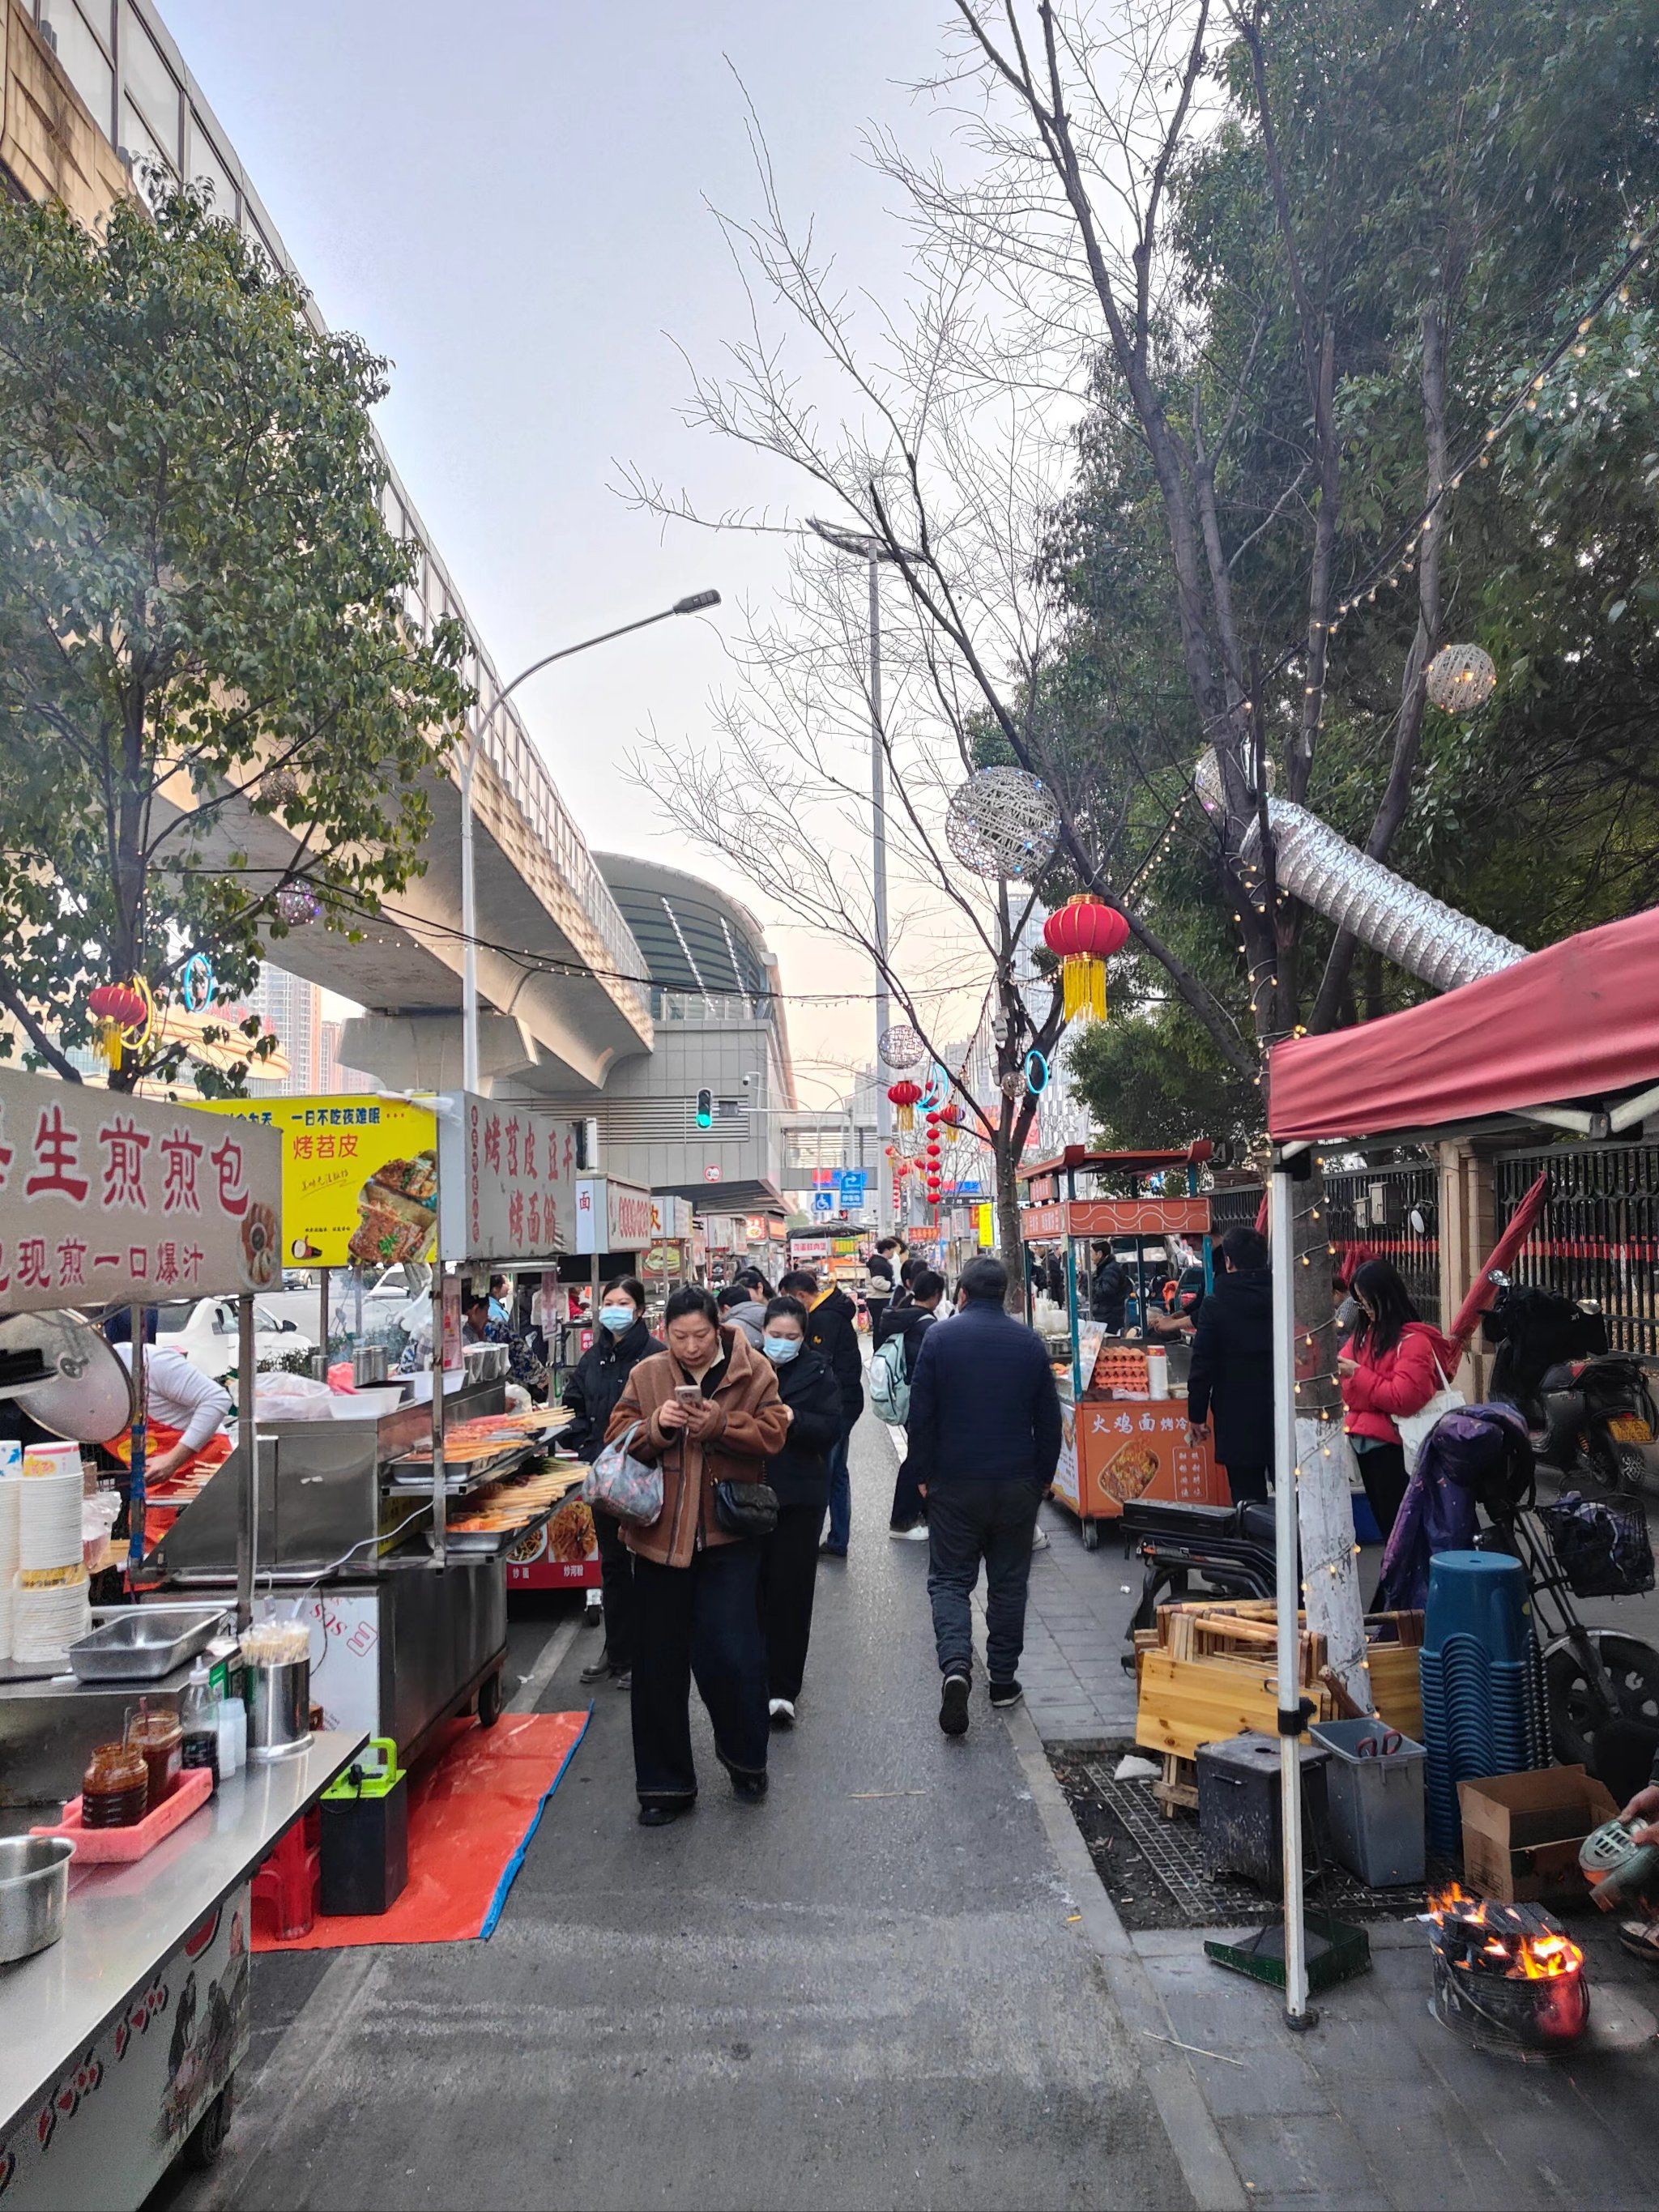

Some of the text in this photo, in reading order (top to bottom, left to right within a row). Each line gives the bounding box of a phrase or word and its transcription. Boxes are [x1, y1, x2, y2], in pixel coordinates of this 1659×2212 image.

[293, 1134, 358, 1159] 烤苕皮
[484, 1112, 538, 1179] 烤苕皮
[0, 1105, 249, 1215] 生煎煎包
[580, 1191, 590, 1211] 面
[1091, 1413, 1156, 1434] 火鸡面
